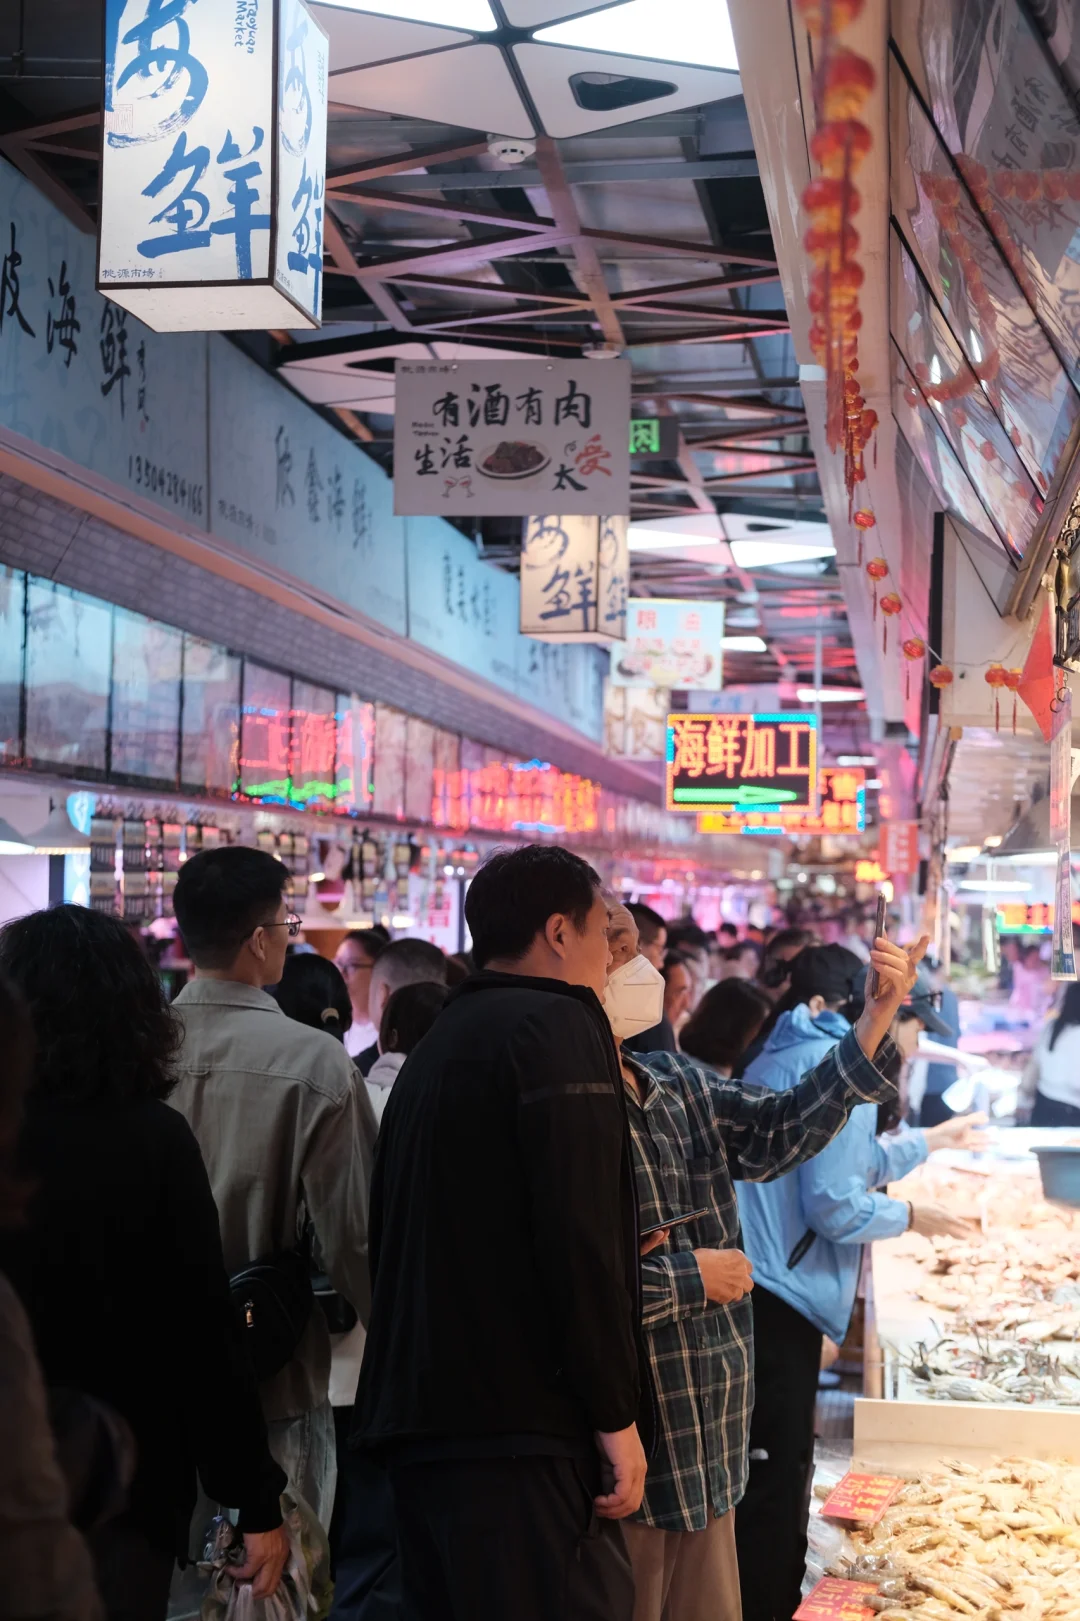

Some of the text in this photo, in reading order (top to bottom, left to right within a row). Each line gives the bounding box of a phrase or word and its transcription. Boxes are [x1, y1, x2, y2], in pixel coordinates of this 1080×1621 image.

[234, 1, 247, 47] Market
[246, 0, 258, 54] Taoyuan
[433, 380, 592, 428] 有酒有肉
[414, 434, 474, 476] 生活
[672, 718, 810, 778] 海鲜加工
